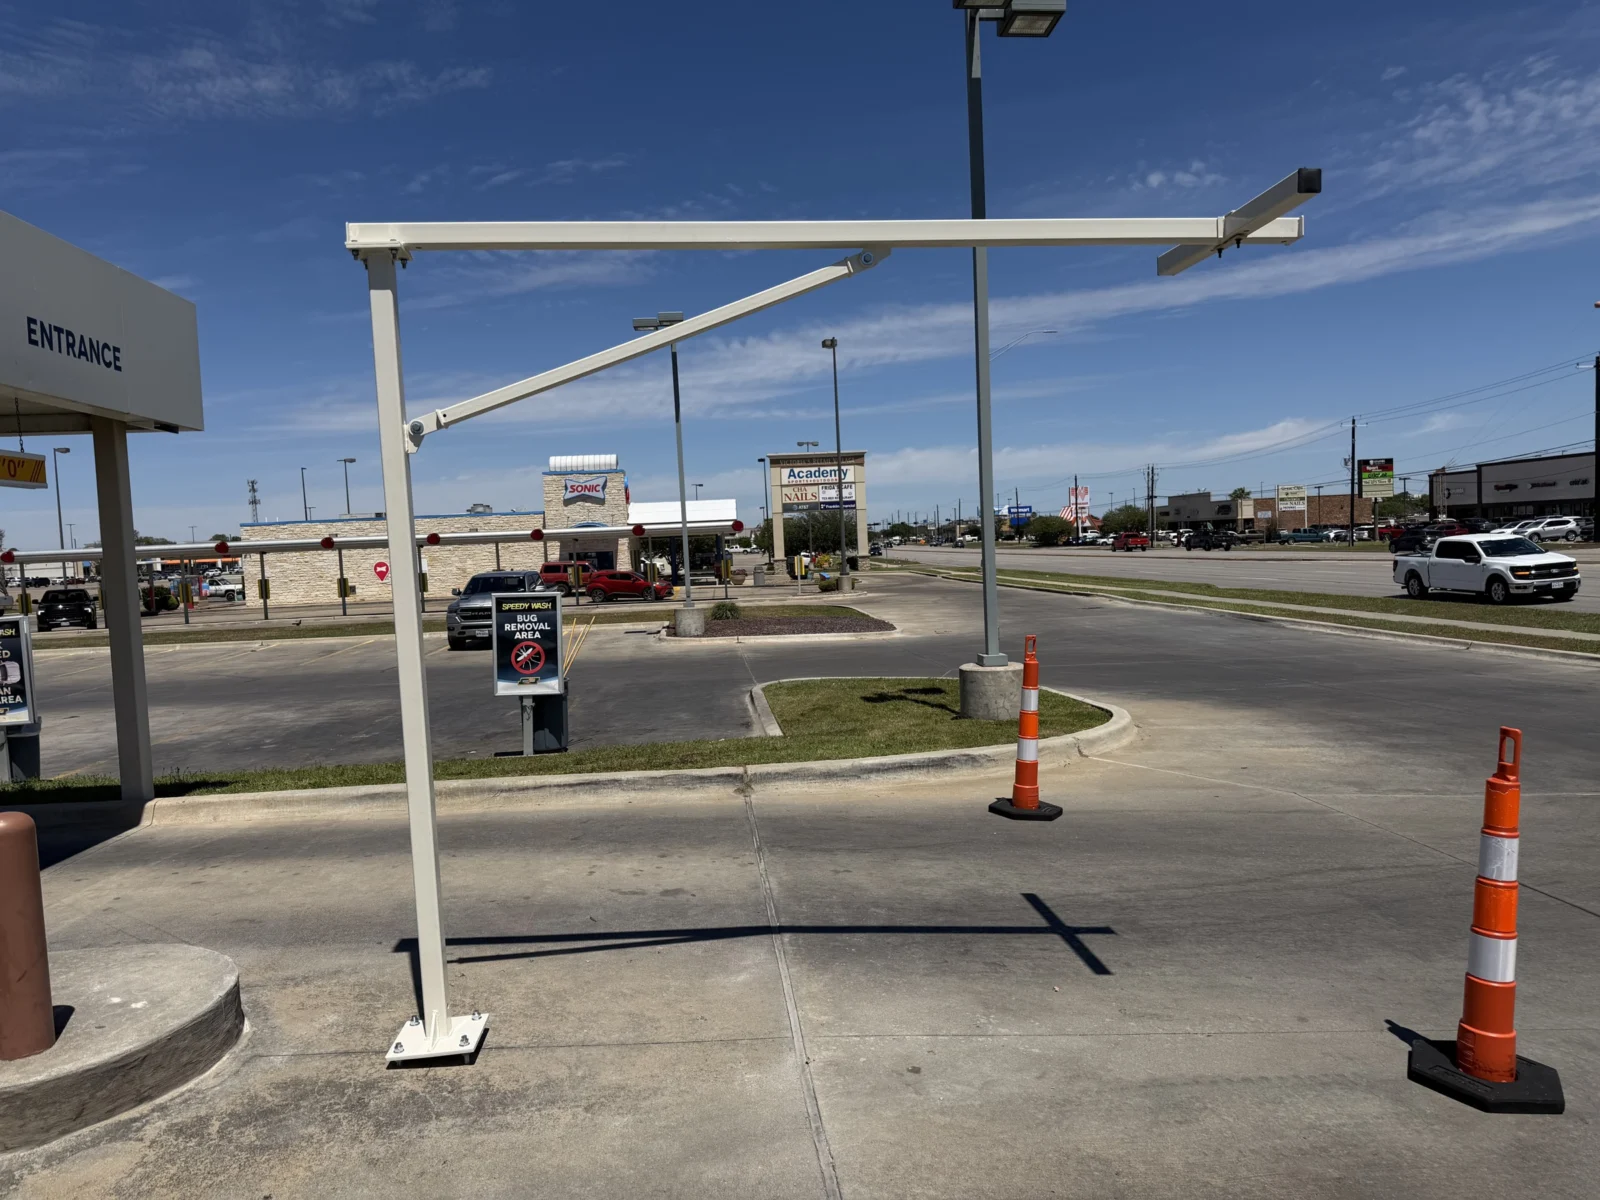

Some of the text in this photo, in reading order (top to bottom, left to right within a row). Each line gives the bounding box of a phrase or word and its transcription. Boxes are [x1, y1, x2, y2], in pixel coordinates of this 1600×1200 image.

[27, 316, 122, 372] ENTRANCE
[788, 468, 848, 480] Academy
[569, 484, 601, 493] SONIC
[784, 492, 817, 501] NAILS
[502, 602, 552, 610] SPEEDY WASH
[516, 614, 538, 622] BUG
[504, 622, 551, 631] REMOVAL
[514, 631, 541, 639] AREA
